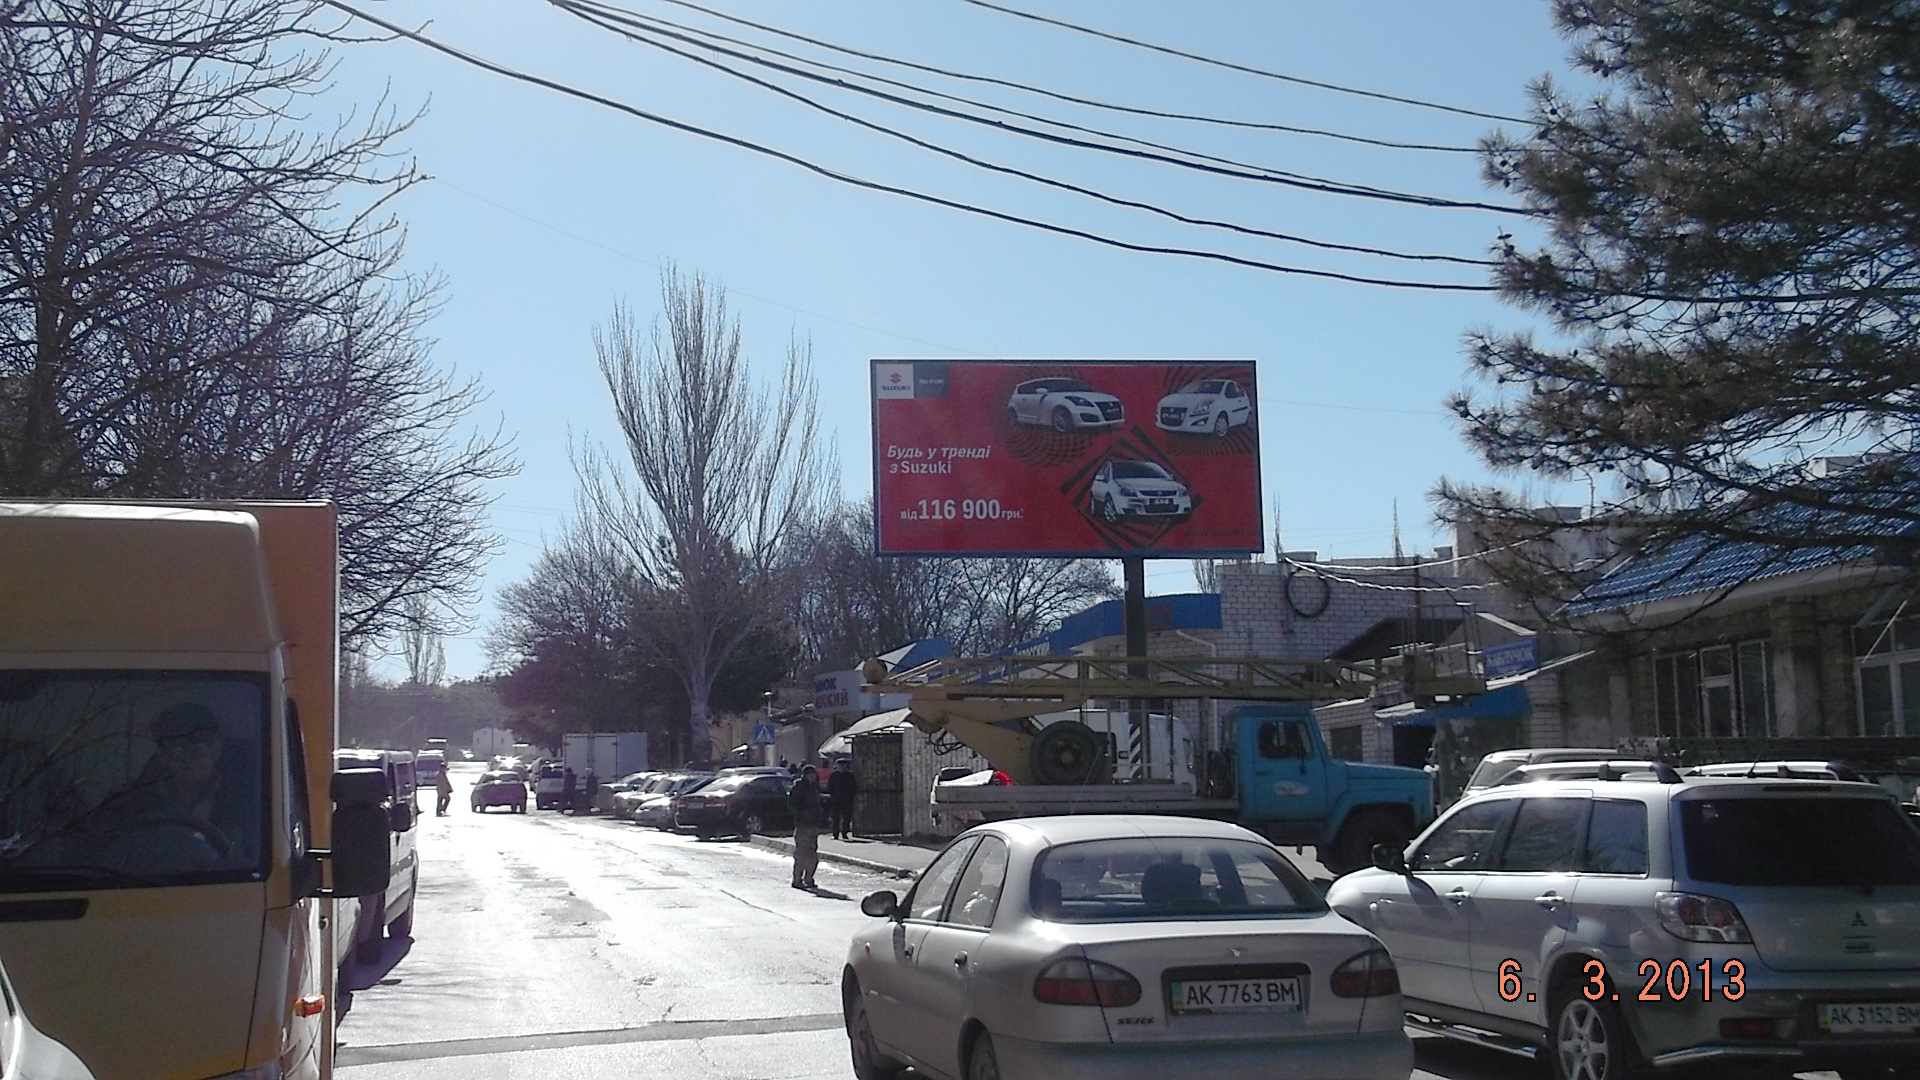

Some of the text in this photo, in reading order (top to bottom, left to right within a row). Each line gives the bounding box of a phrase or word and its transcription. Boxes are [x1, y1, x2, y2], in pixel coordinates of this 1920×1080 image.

[887, 445, 991, 460] Будь у тренді
[889, 461, 952, 474] з Suzuki
[900, 508, 918, 520] від
[918, 499, 956, 520] 116
[962, 498, 1001, 520] 900
[1187, 981, 1296, 1005] AK 7763 BM
[1857, 1006, 1893, 1024] 3152
